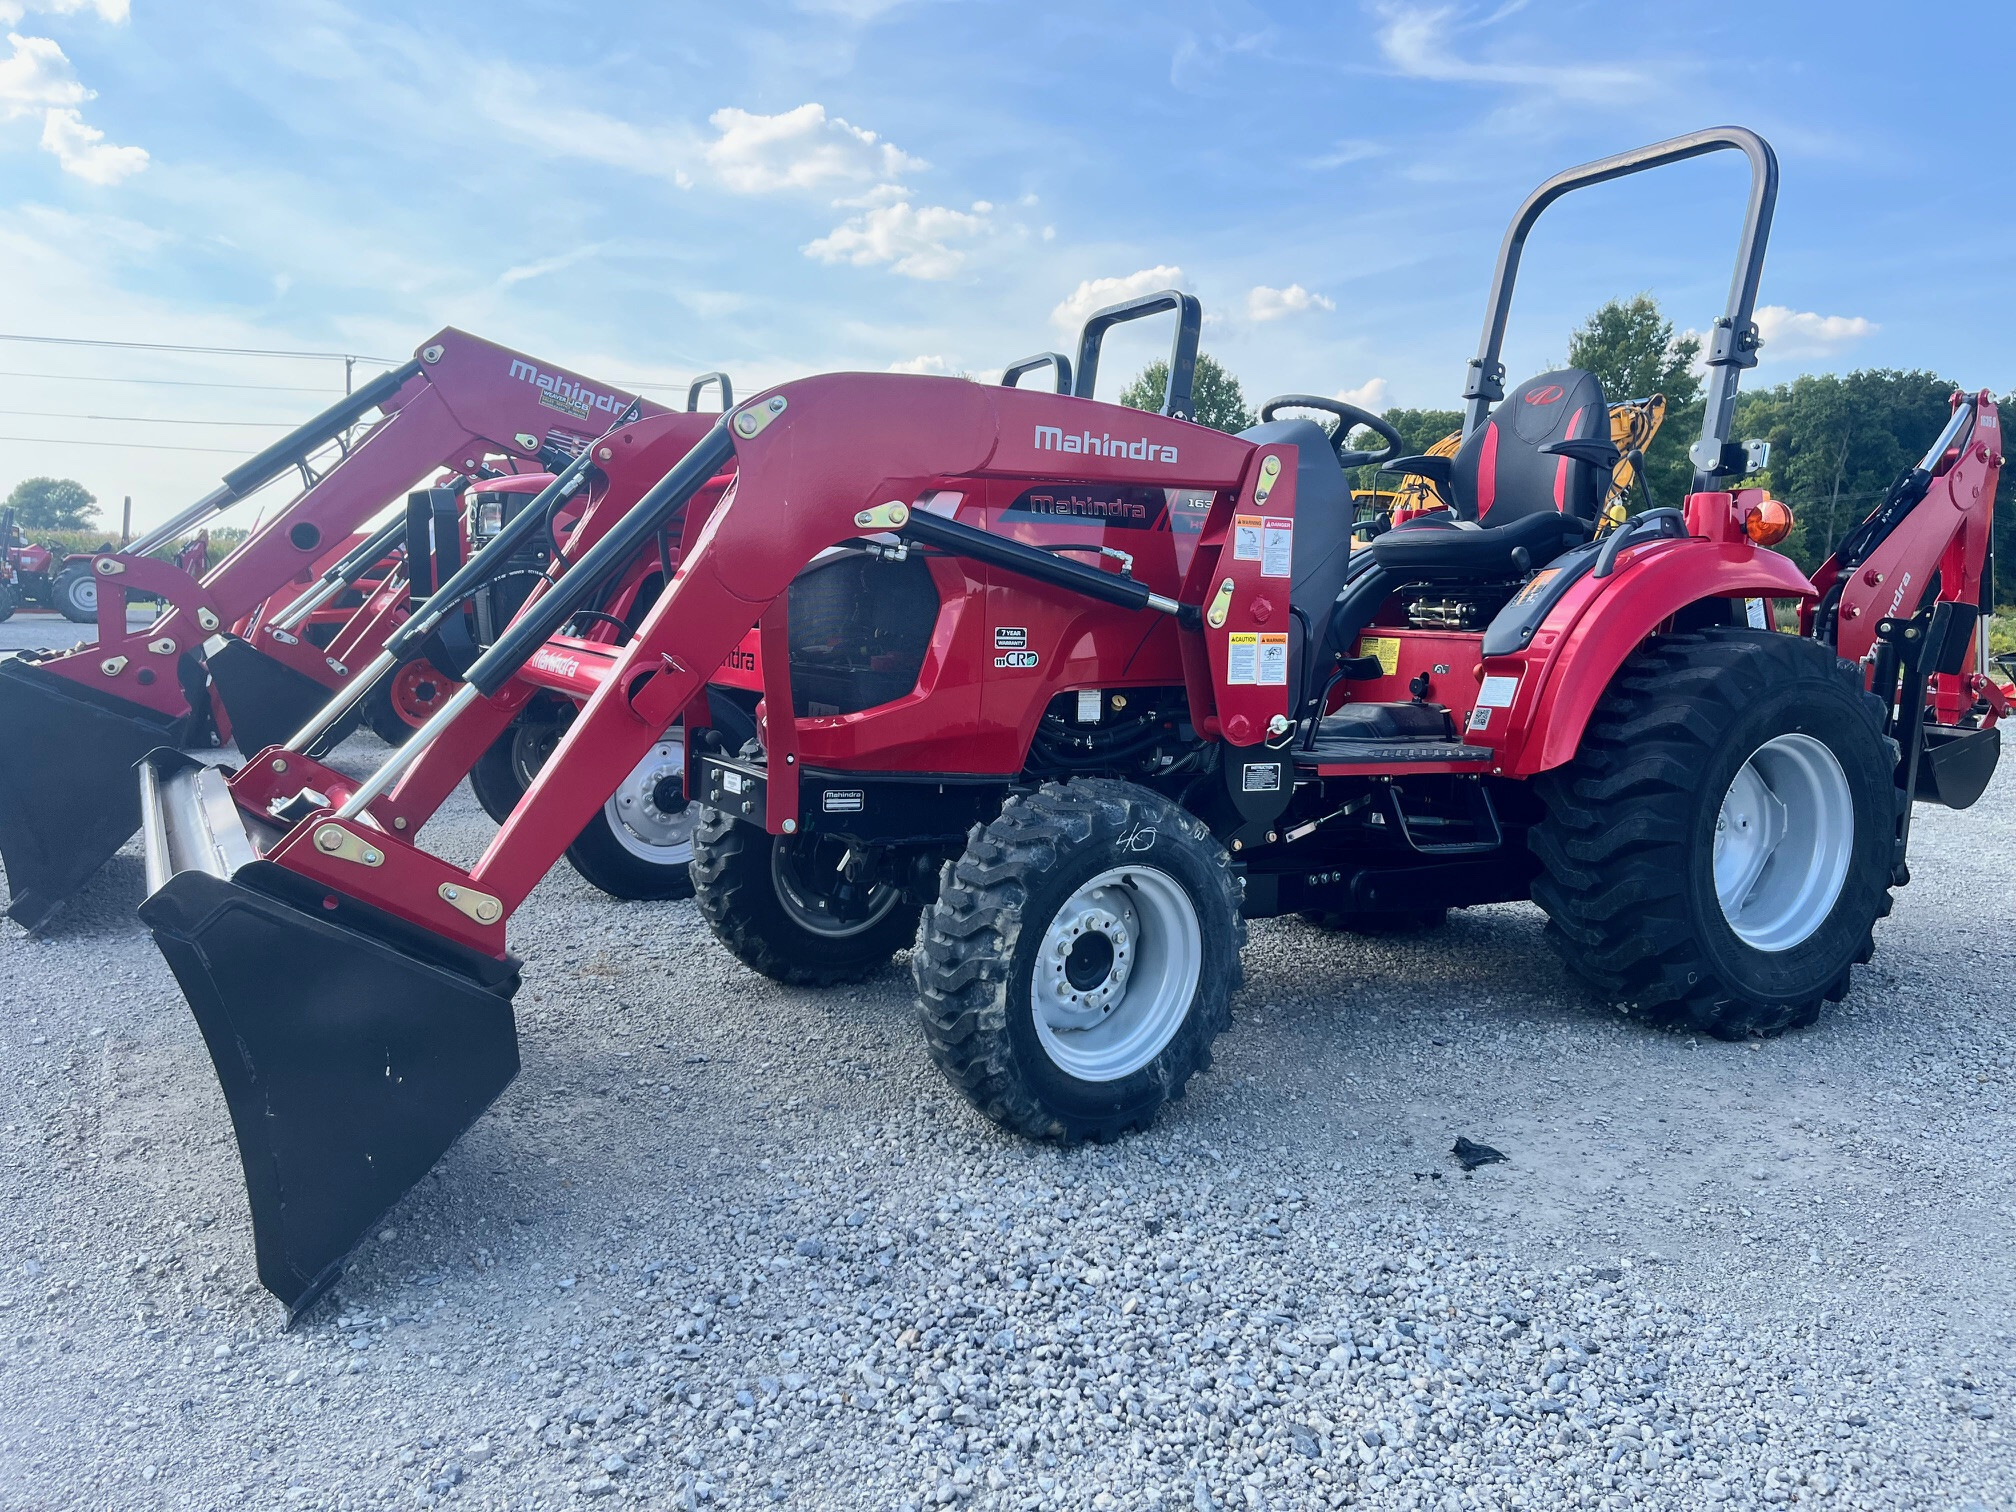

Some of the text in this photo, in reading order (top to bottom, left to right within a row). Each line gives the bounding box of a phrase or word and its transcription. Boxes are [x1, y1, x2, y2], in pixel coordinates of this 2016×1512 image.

[543, 389, 567, 403] WEAVER
[568, 400, 589, 411] JCB
[1034, 425, 1178, 463] Mahindra
[1030, 495, 1146, 519] Mahindra
[531, 649, 580, 678] Mahindra
